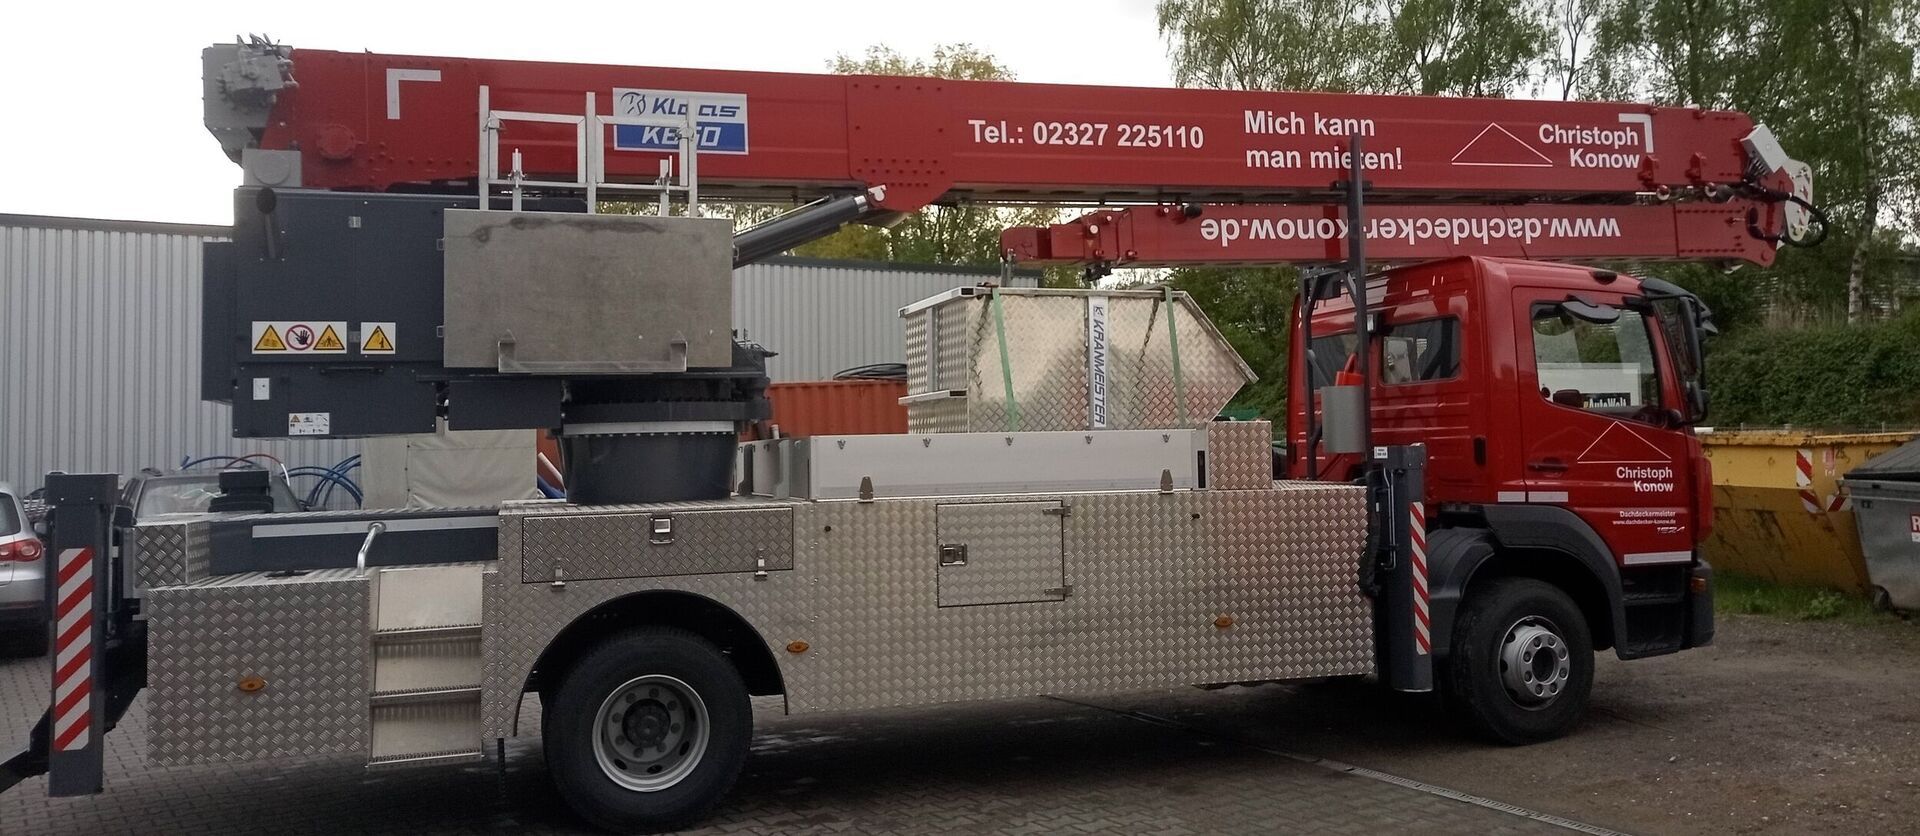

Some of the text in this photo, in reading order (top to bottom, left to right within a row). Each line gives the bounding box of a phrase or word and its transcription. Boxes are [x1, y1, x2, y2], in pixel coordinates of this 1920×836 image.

[1244, 110, 1375, 136] Mich kann
[968, 119, 1204, 149] Tel.: 02327 225110
[1538, 123, 1639, 149] Christoph
[1246, 149, 1301, 168] man
[1569, 148, 1640, 169] Konow
[1093, 318, 1106, 425] KRANMEISTER
[1616, 466, 1673, 481] Christoph
[1633, 480, 1674, 493] Konow
[1619, 510, 1676, 518] Dachdeckermeister
